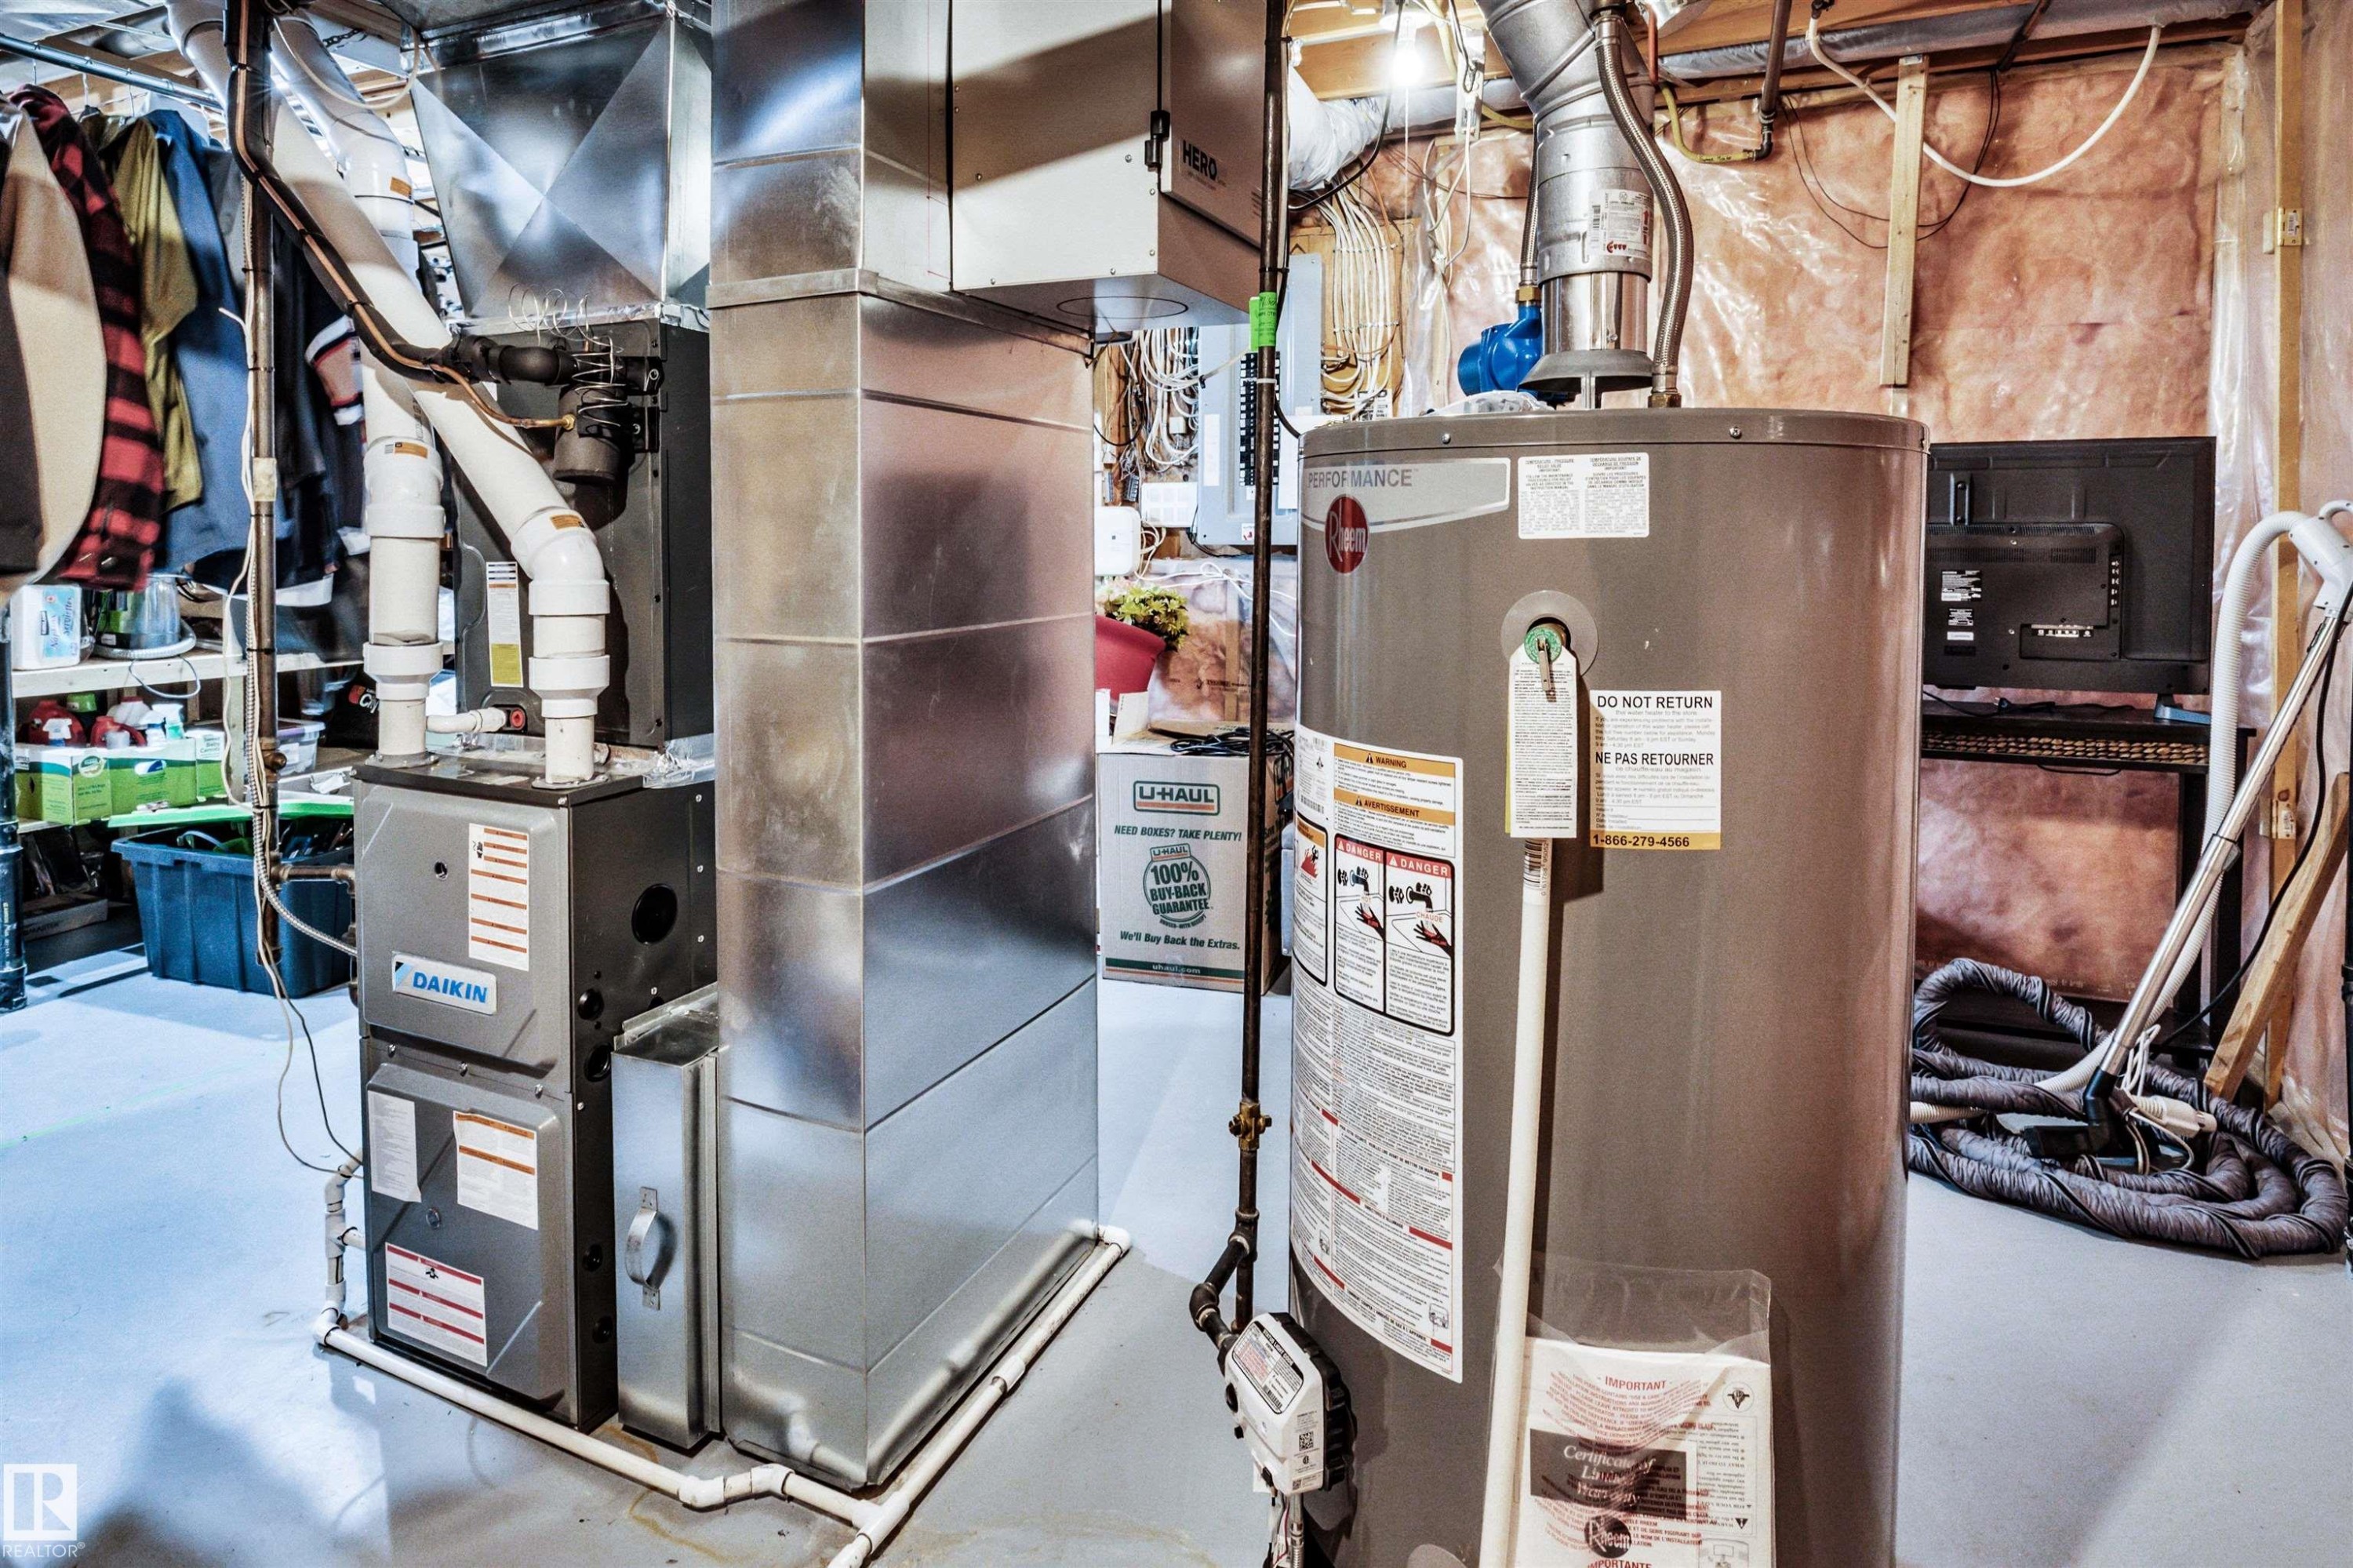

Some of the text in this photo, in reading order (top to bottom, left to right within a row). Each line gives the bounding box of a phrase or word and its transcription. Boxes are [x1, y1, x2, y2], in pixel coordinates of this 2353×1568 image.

[1183, 140, 1217, 180] HERO
[1328, 499, 1366, 562] Rheem
[1598, 696, 1713, 708] DO NOT RETURN
[1376, 756, 1407, 768] WARNING
[1595, 751, 1714, 766] NE PAS RETOURNER
[1140, 786, 1214, 803] U-HAUL
[1365, 800, 1420, 817] AVERTISSEMENT
[1115, 825, 1242, 842] NEED BOXES? TAKE PLENTY!
[1593, 833, 1689, 847] 1-866-279-4566
[1153, 846, 1187, 856] U-HAUL
[1346, 841, 1381, 862] DANGER
[1151, 860, 1199, 885] 100%
[1400, 859, 1448, 876] DANGER
[1150, 882, 1206, 901] BUY-BACK
[1152, 898, 1210, 915] GUARANTEE
[1416, 911, 1443, 922] CHAUDE
[1120, 930, 1240, 950] We'll Buy Back the Extras.
[1152, 964, 1201, 974] uhaul.com
[413, 972, 488, 1003] DAIKIN
[1605, 1376, 1667, 1391] IMPORTANT
